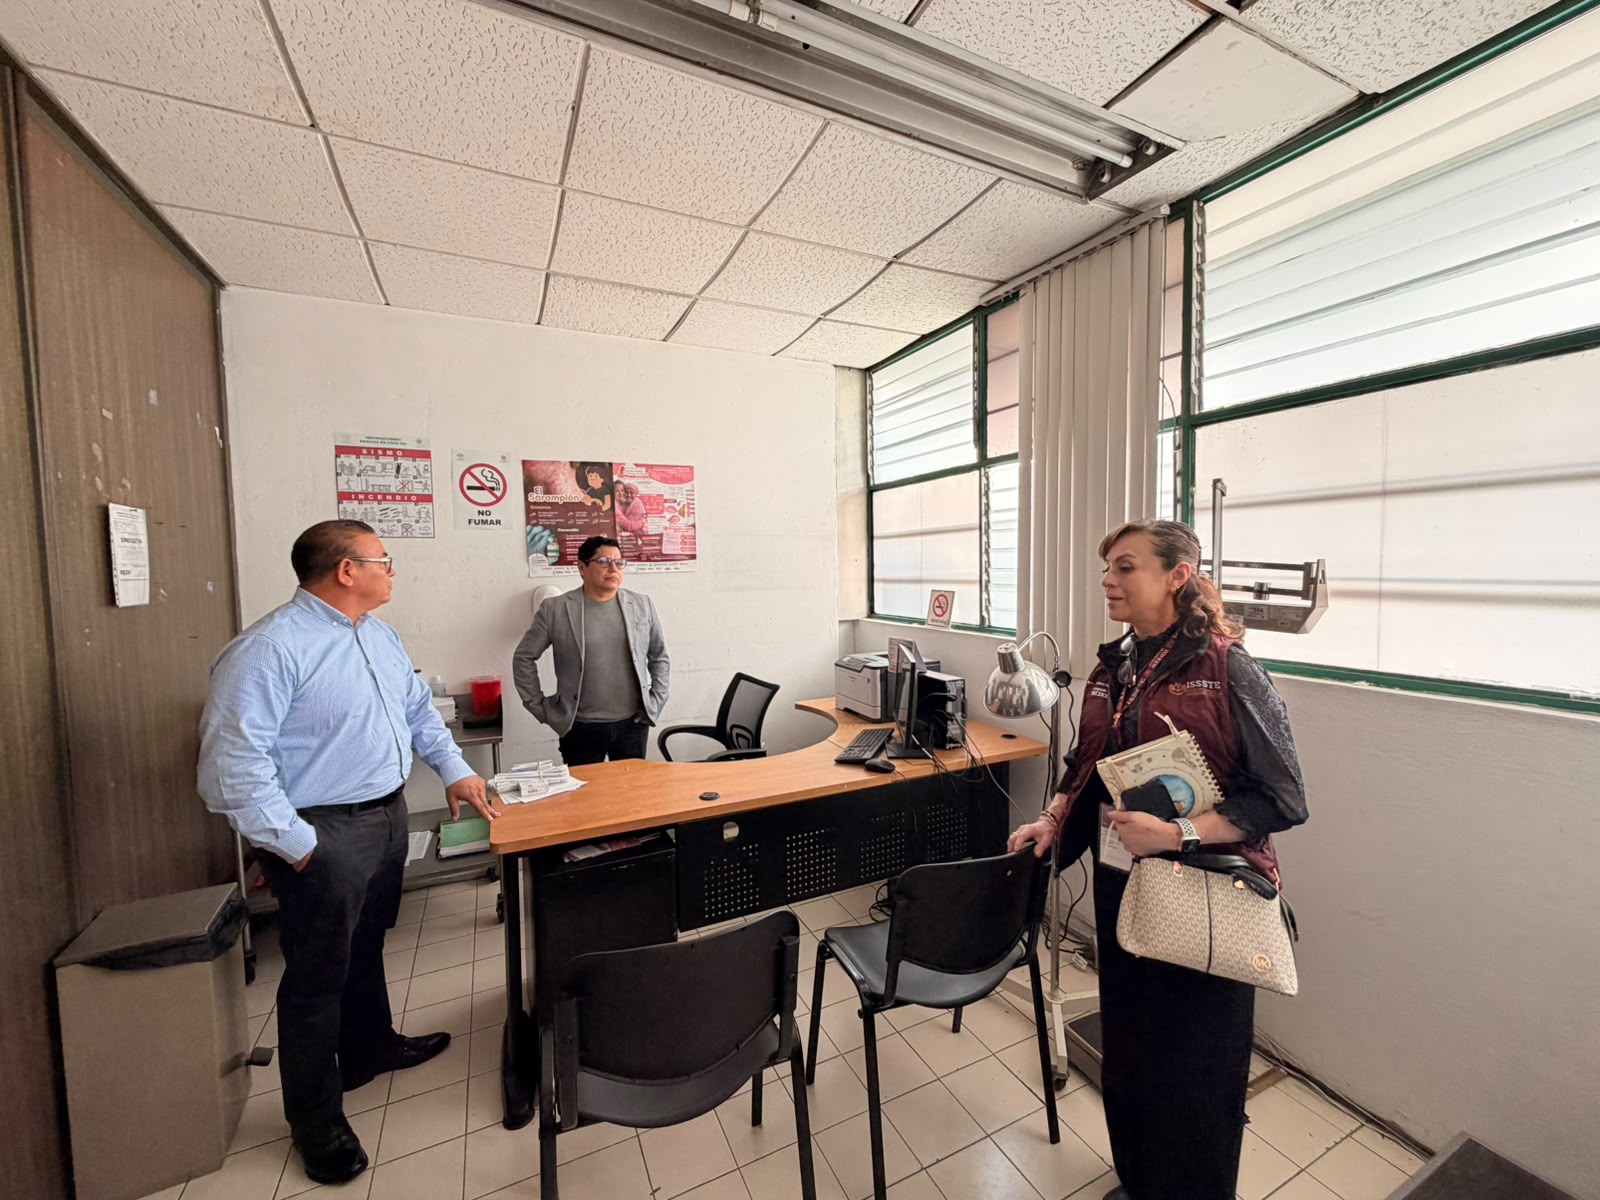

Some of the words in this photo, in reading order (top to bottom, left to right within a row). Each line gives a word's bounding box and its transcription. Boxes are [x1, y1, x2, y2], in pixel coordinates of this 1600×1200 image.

[534, 487, 543, 495] El
[351, 493, 417, 501] INCENDIO
[477, 509, 492, 517] NO
[467, 518, 502, 526] FUMAR
[1186, 680, 1221, 690] ISSSTE
